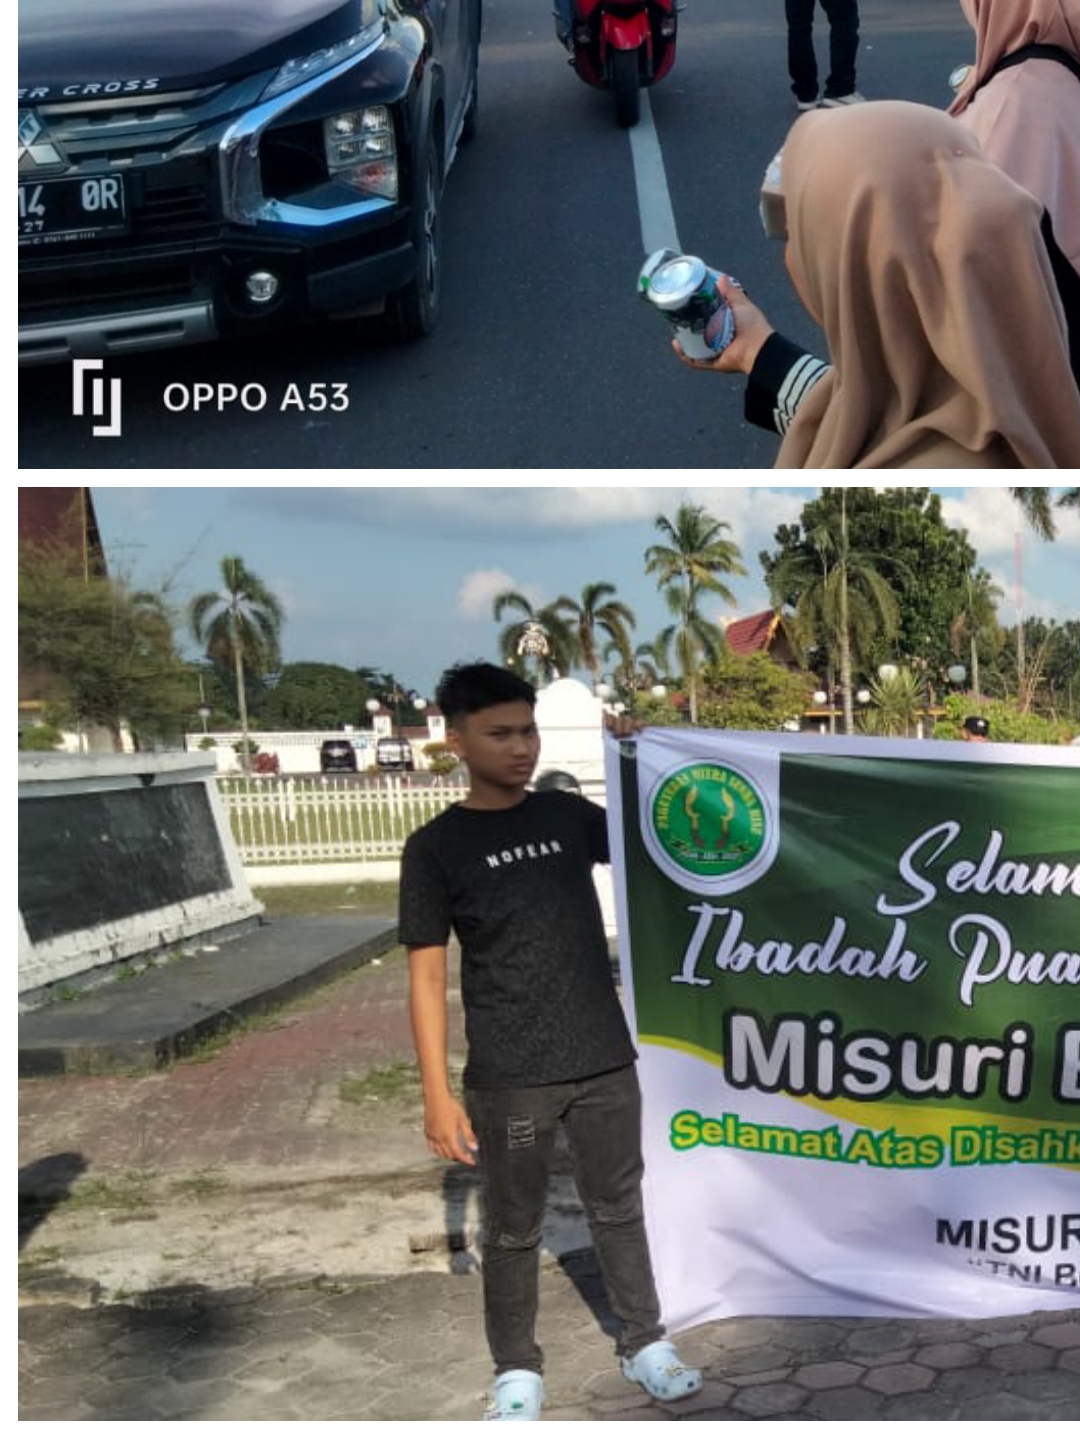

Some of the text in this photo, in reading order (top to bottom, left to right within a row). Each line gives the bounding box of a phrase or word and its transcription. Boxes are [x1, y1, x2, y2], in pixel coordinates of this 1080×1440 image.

[62, 78, 160, 95] CROSS
[18, 184, 46, 218] 14
[670, 902, 928, 987] Ibadah
[727, 1010, 1033, 1100] Misuri
[669, 1110, 838, 1161] Selamat
[847, 1130, 942, 1167] Atas
